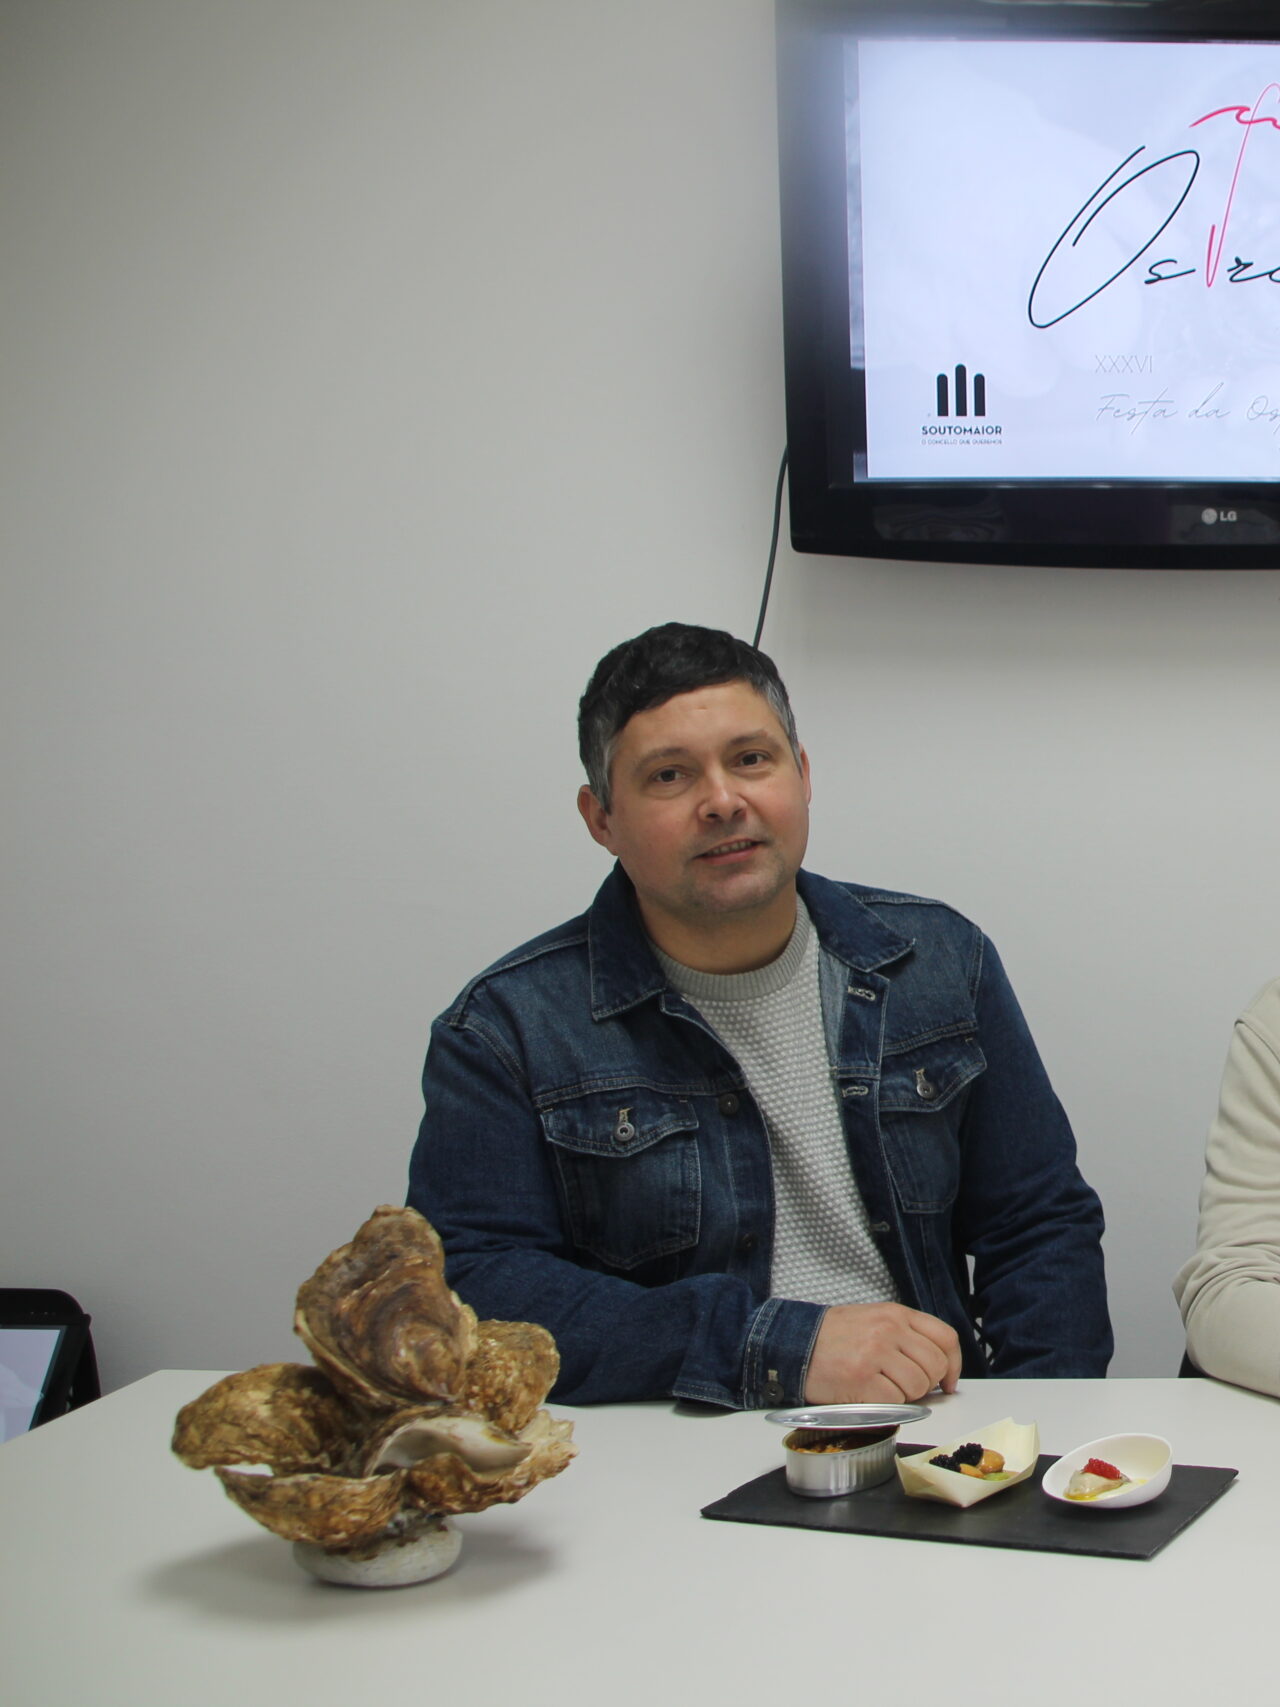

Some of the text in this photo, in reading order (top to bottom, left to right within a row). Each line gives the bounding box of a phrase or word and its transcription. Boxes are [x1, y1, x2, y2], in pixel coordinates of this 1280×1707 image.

[1095, 355, 1153, 373] XXXVI
[1096, 387, 1178, 435] Festa
[1188, 381, 1232, 419] da
[921, 425, 1002, 435] SOUTOMAIOR
[1220, 510, 1237, 521] LG
